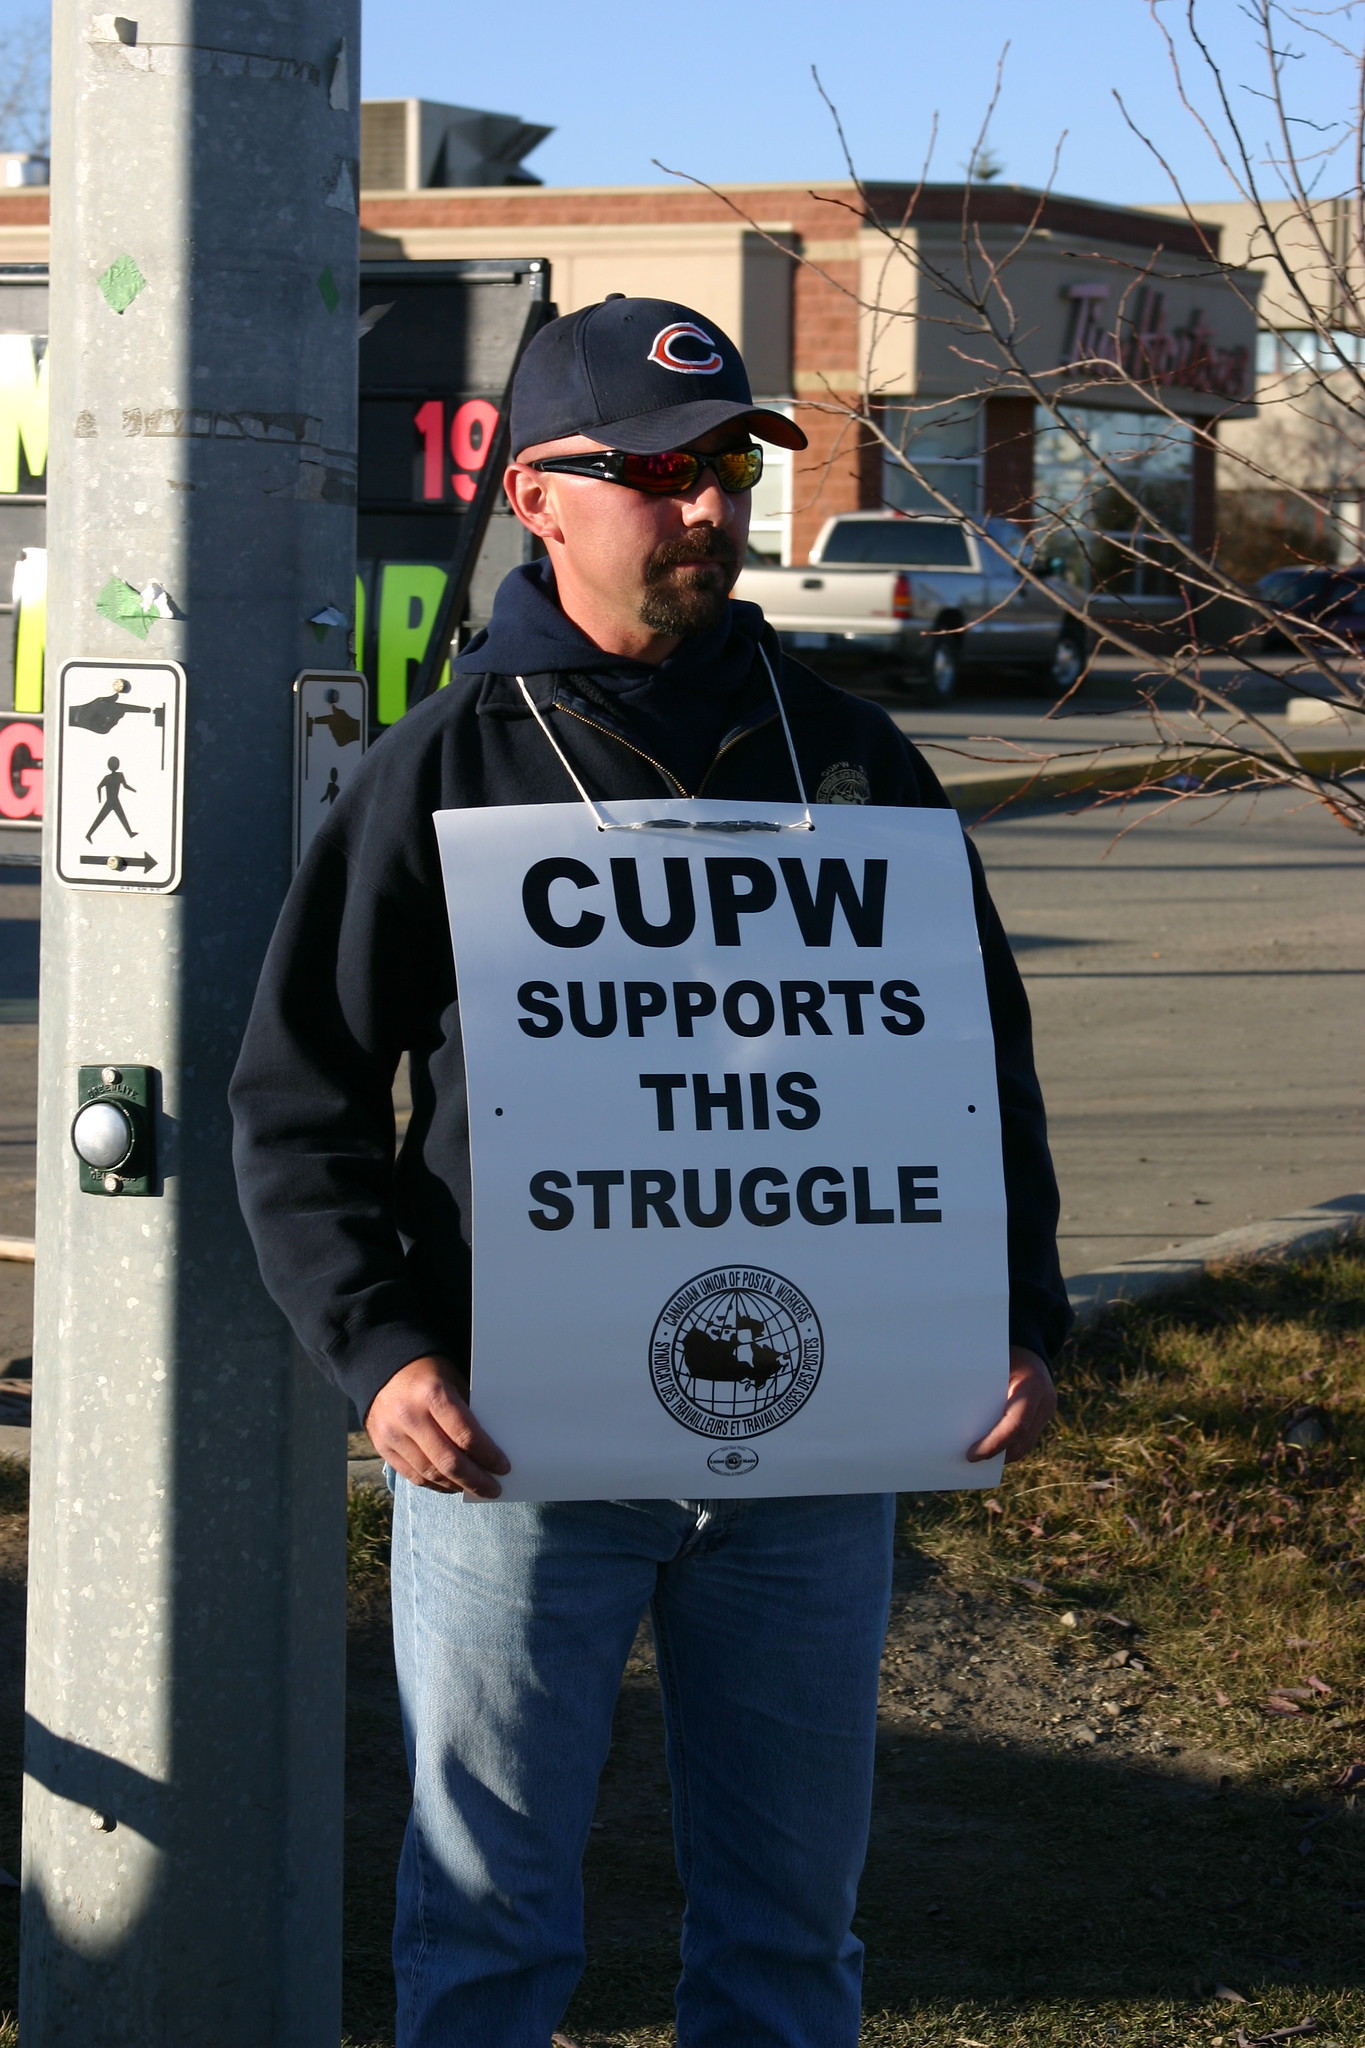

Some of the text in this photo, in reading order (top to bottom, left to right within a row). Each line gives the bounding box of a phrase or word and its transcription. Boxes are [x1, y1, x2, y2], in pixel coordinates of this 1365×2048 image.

[648, 322, 723, 375] C
[522, 857, 888, 948] CUPW
[517, 979, 925, 1039] SUPPORTS
[639, 1071, 821, 1132] THIS
[528, 1165, 942, 1232] STRUGGLE
[663, 1271, 813, 1327] CANADIAN UNION OF POSTAL WORKERS
[654, 1337, 820, 1436] SYNDICAT DES TRAVAILLEURS ET TRAVAILLEUSES DES POSTES
